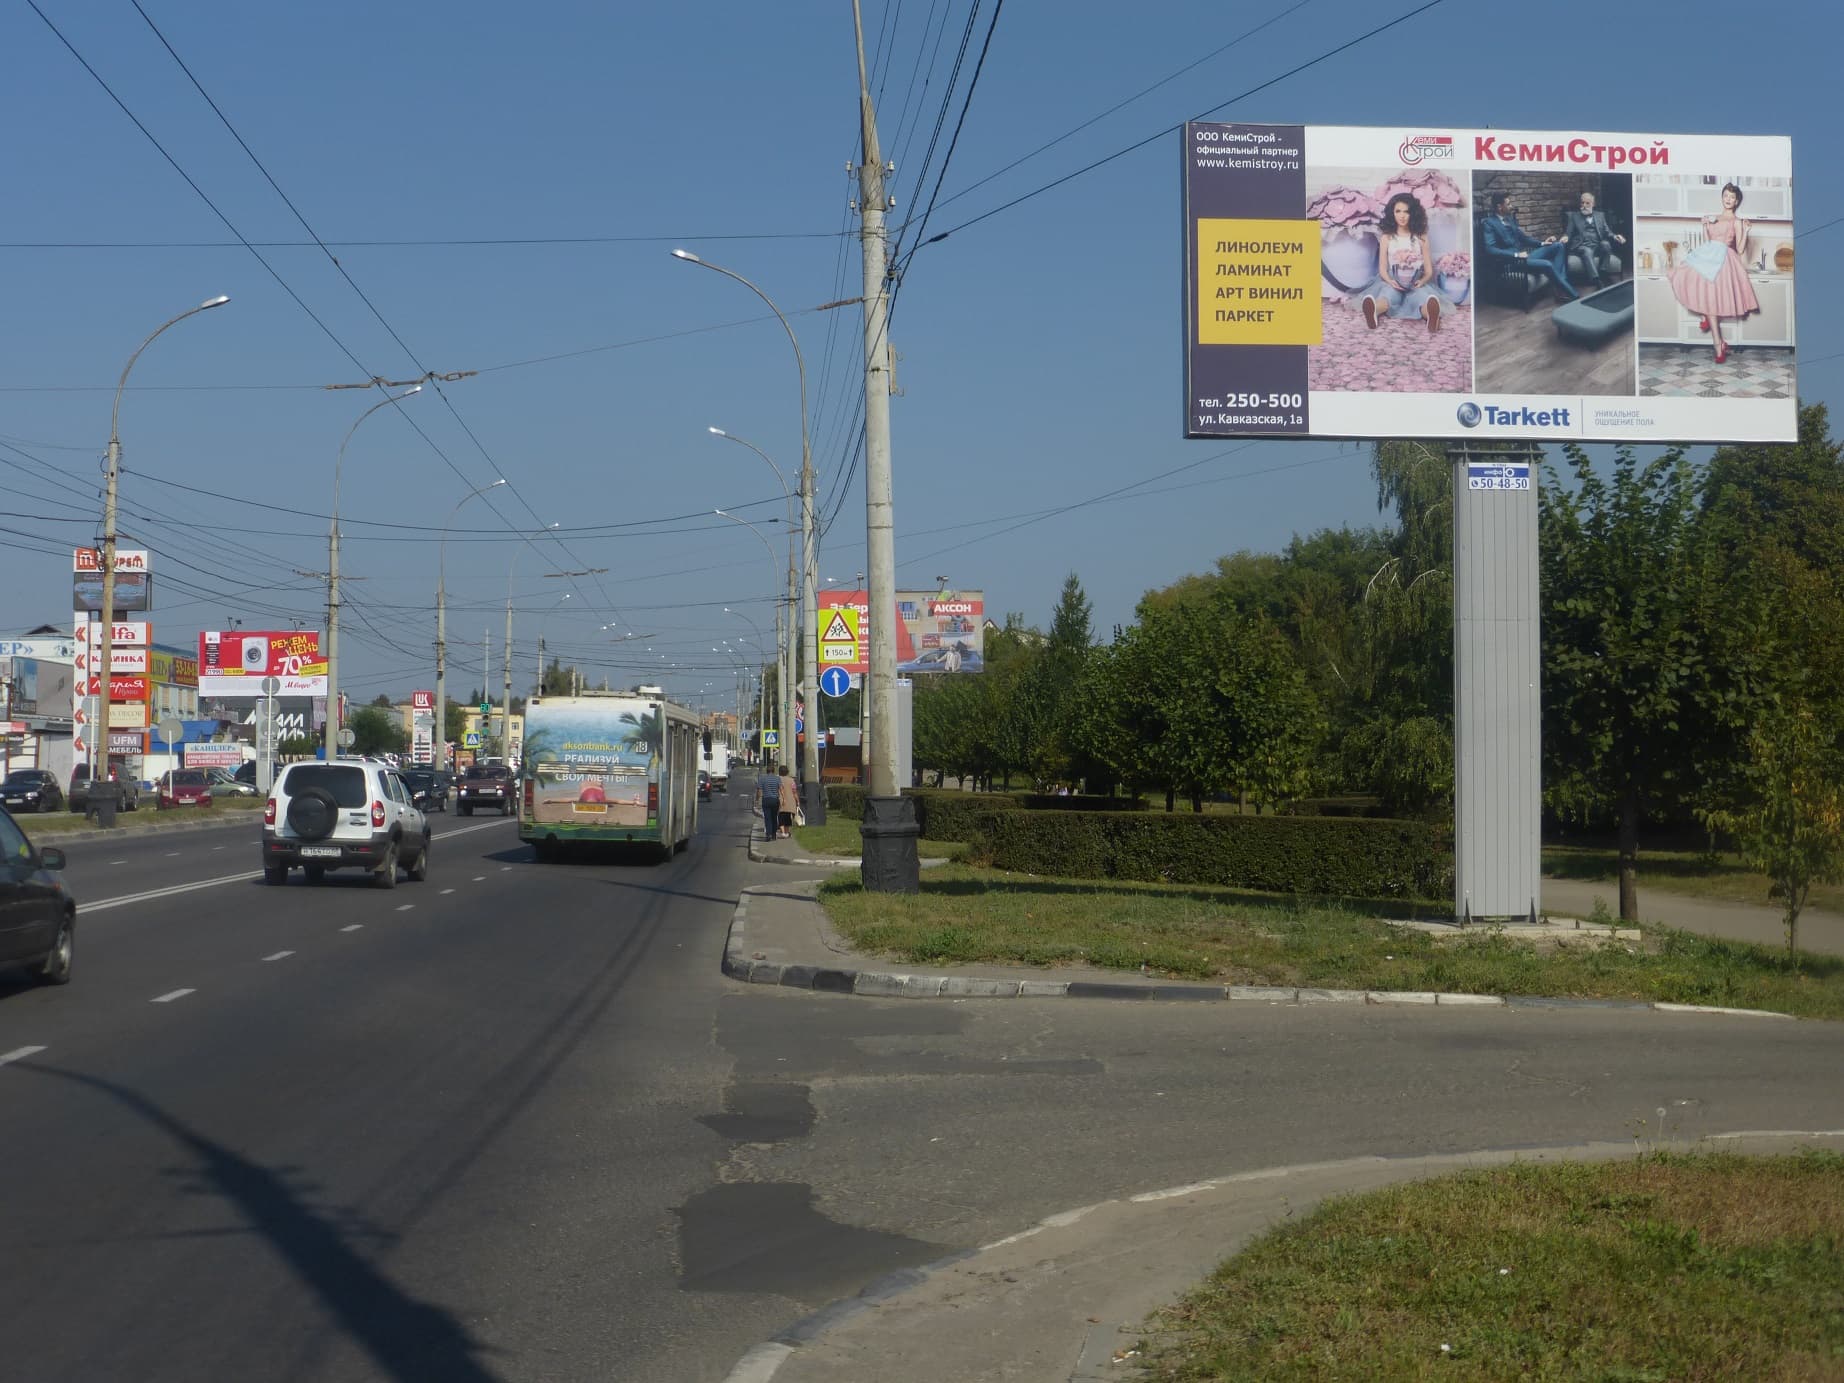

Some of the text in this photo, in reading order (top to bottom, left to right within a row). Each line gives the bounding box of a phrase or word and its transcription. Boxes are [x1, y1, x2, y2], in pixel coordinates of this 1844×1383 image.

[1196, 131, 1219, 141] ООО
[1222, 132, 1276, 144] КемиСтрой
[1196, 145, 1299, 156] официальный партнер
[1474, 136, 1670, 170] КемиСтрой
[1197, 158, 1299, 171] www.kemistroy.ru
[1215, 241, 1304, 254] ЛИНОЛЕУМ
[1215, 264, 1292, 276] ЛАМИНАТ
[1215, 287, 1304, 300] АРТ ВИНИЛ
[1215, 310, 1275, 322] ПАРКЕТ
[1199, 393, 1303, 408] тел. 250-500
[1199, 413, 1303, 426] ул. Кавказская, 1а
[1484, 405, 1571, 427] Tarkett
[1594, 410, 1640, 418] УНИКАЛЬНОЕ
[1594, 418, 1655, 426] ОЩУЩЕНИЕ ПОЛА
[1480, 478, 1528, 489] 50-48-50
[933, 604, 972, 613] АКСОН
[99, 626, 136, 640] lfa
[112, 735, 137, 745] UFM
[564, 753, 620, 764] РЕАЛИЗУЙ
